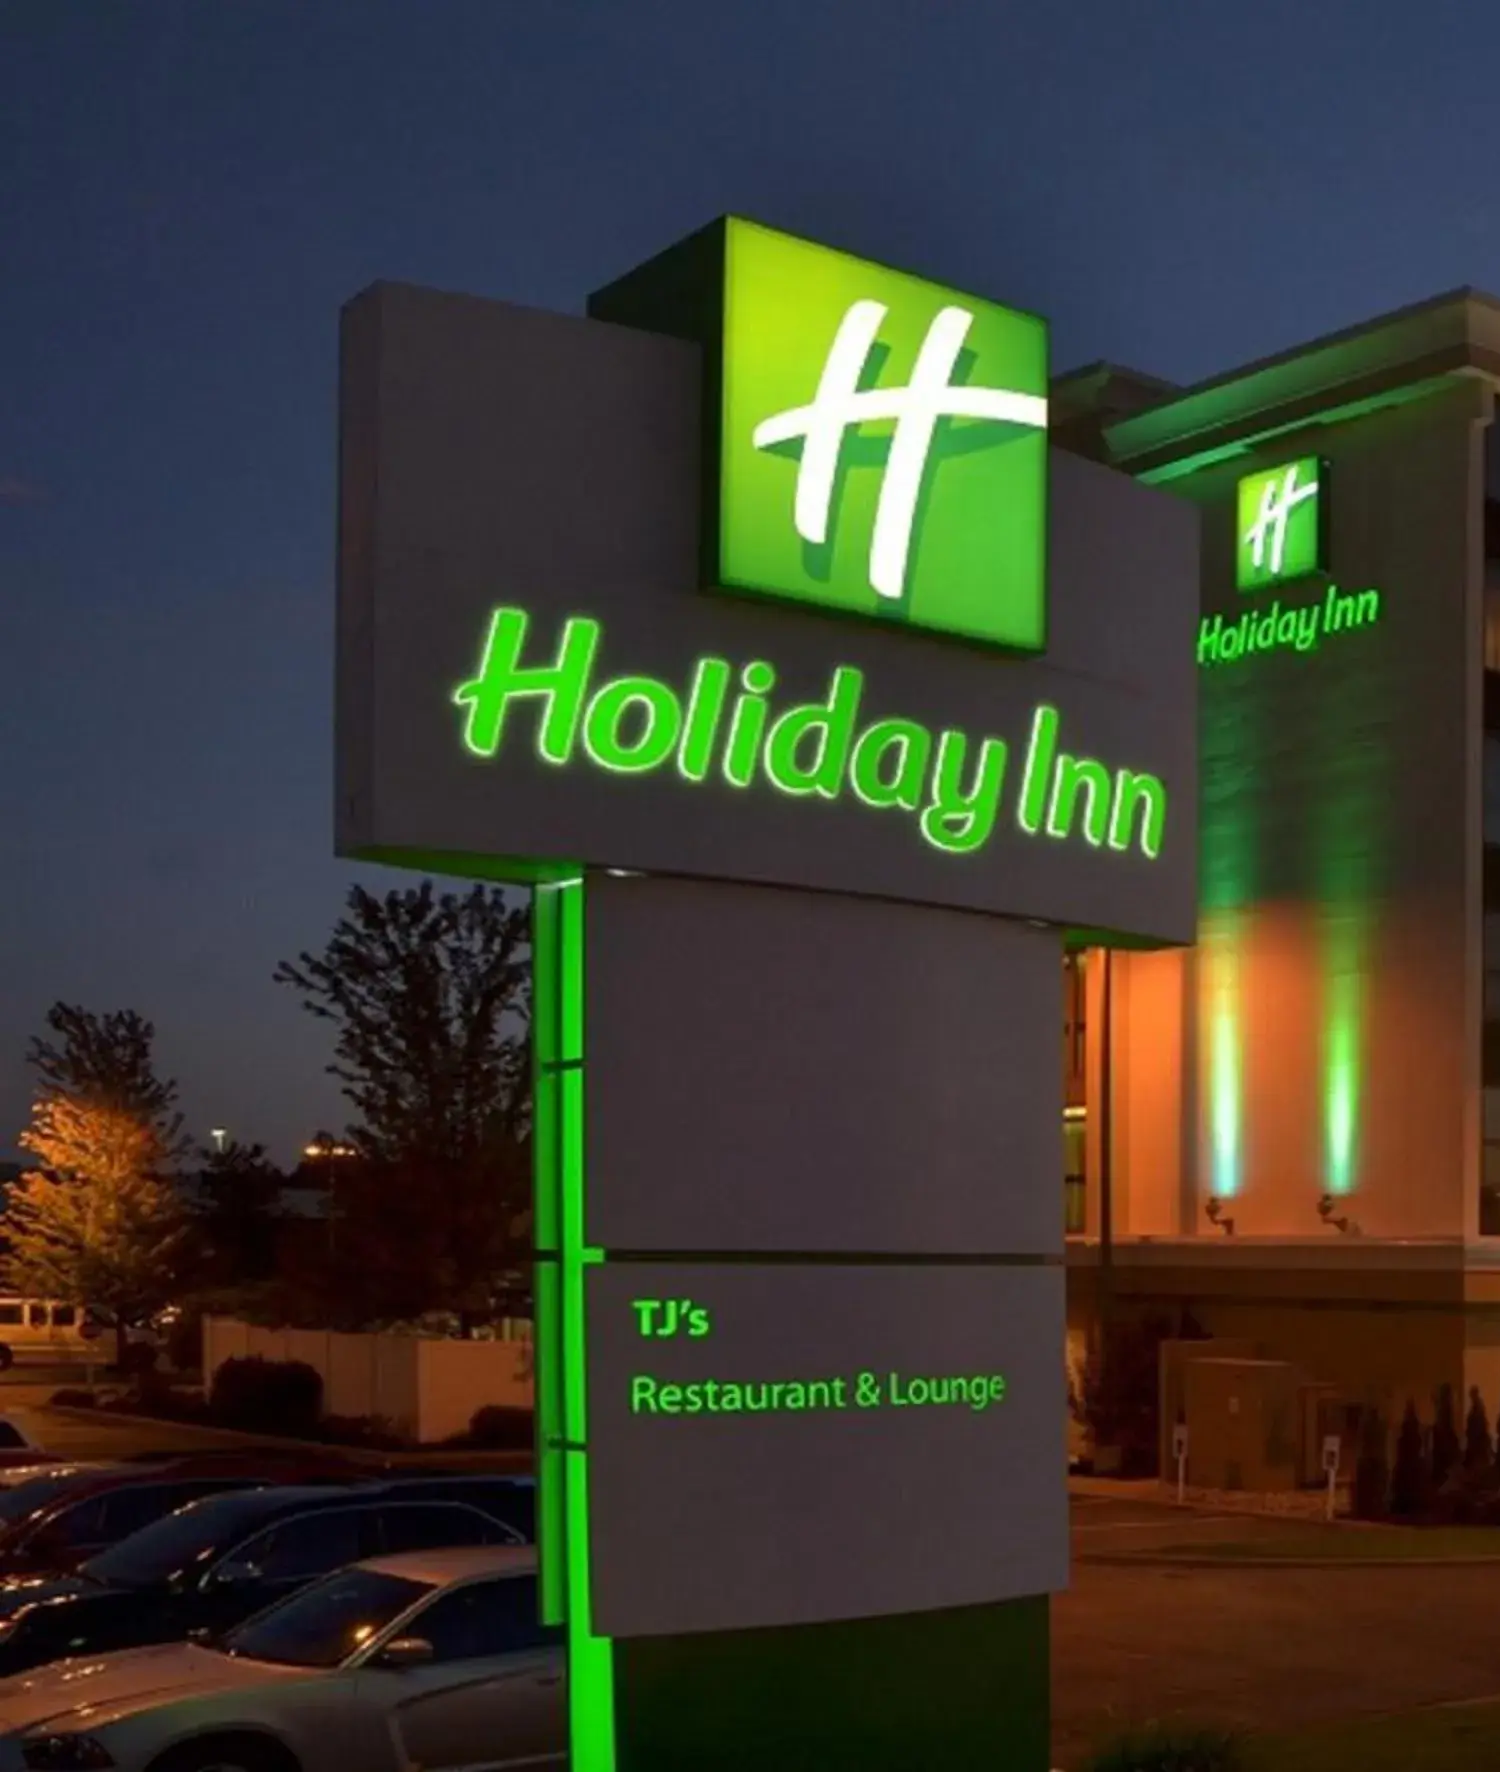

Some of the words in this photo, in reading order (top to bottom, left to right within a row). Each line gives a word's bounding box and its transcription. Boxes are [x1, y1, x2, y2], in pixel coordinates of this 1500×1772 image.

[1198, 600, 1320, 664] Holiday
[1322, 584, 1380, 632] Inn
[451, 605, 1007, 854] Holiday
[1016, 704, 1168, 858] Inn
[632, 1299, 709, 1337] TJ's
[630, 1374, 847, 1414] Restaurant
[855, 1371, 881, 1408] &
[889, 1372, 1006, 1411] Lounge
